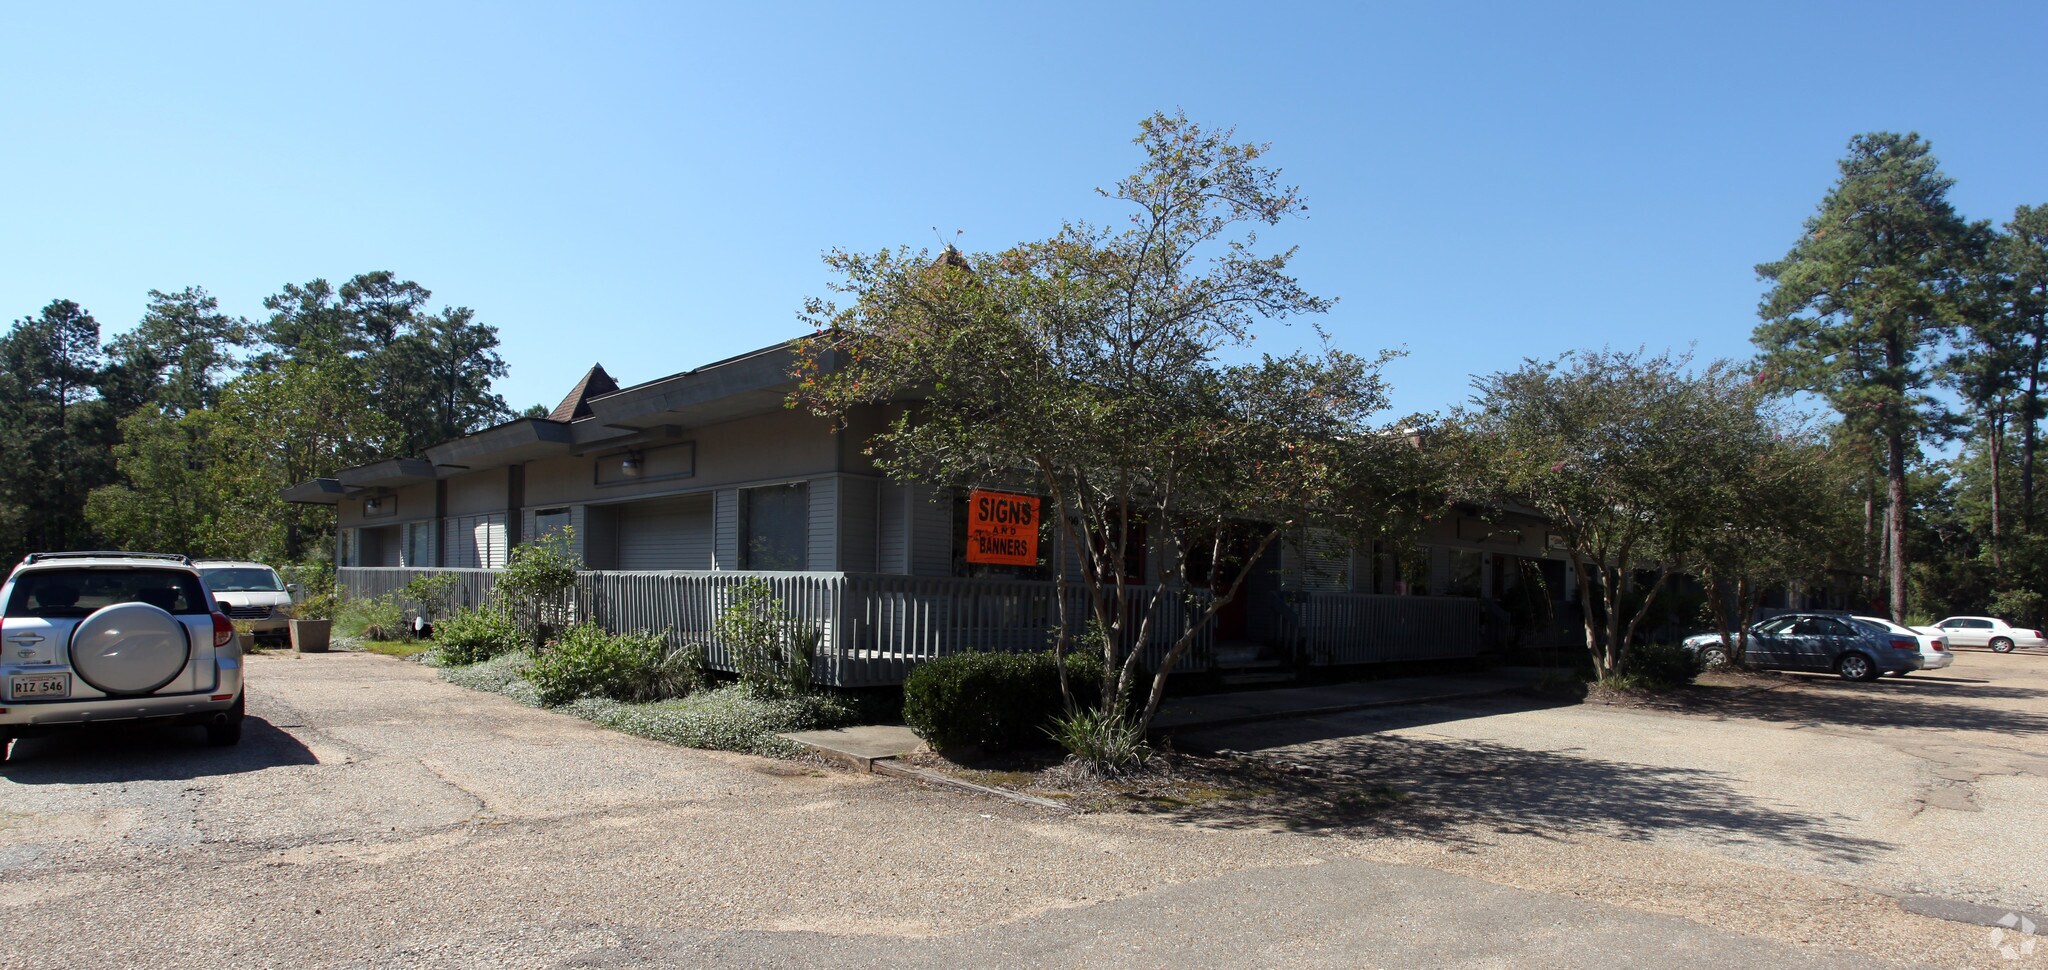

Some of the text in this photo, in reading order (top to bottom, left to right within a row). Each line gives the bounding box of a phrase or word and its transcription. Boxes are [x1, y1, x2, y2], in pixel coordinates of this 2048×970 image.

[979, 497, 1032, 525] SIGNS
[993, 526, 1016, 535] AND
[979, 537, 1027, 556] BANNERS
[15, 682, 63, 692] RIZ 546
